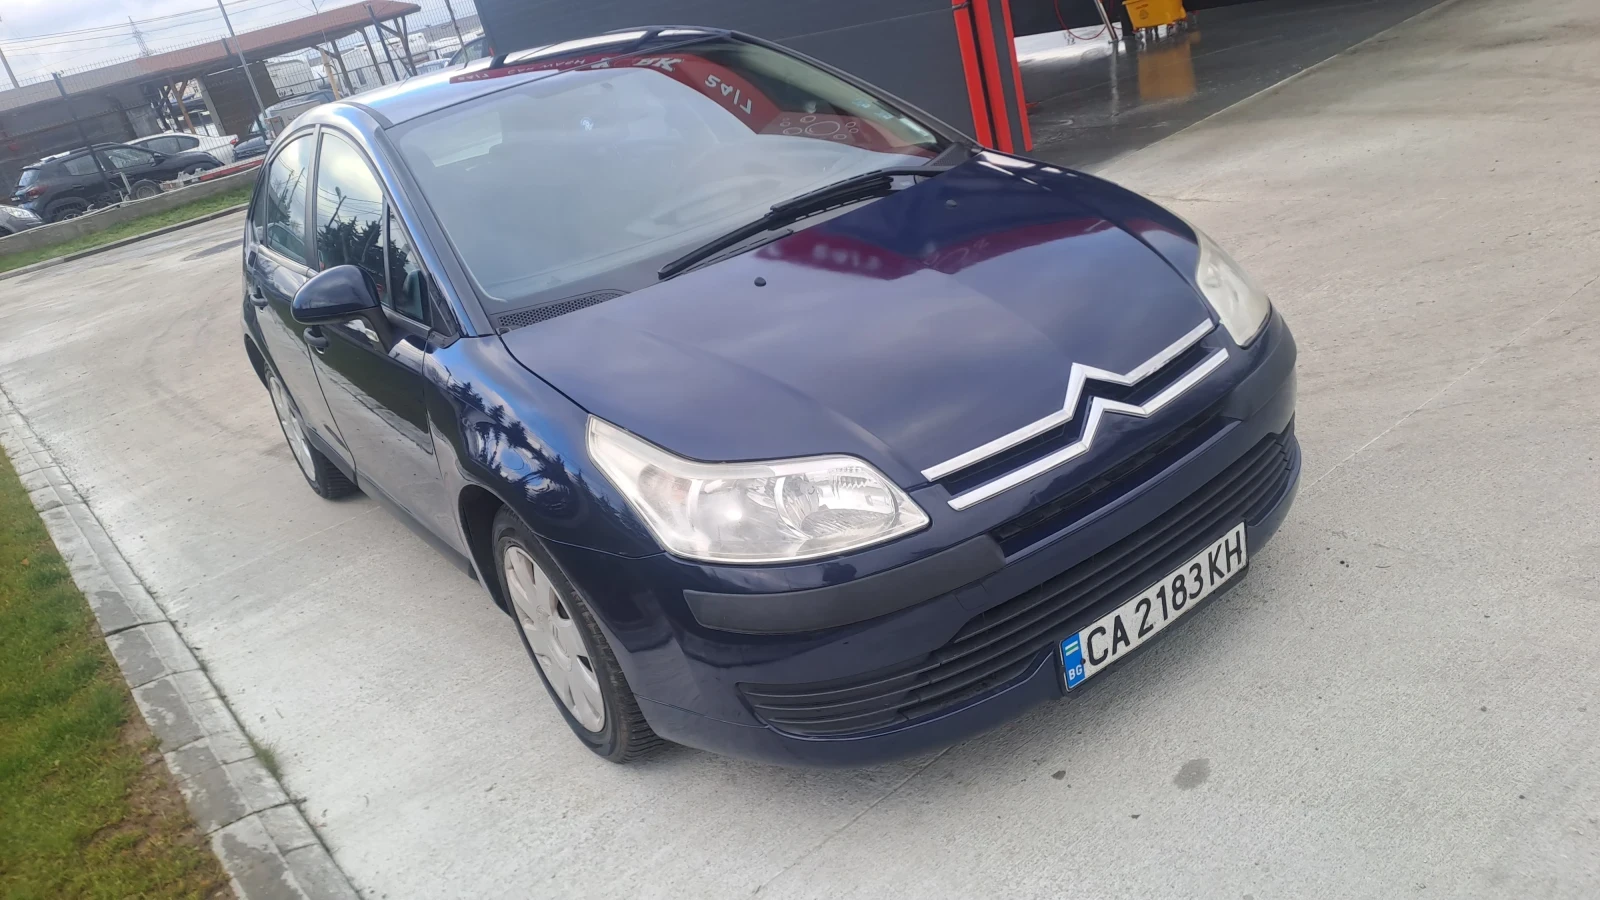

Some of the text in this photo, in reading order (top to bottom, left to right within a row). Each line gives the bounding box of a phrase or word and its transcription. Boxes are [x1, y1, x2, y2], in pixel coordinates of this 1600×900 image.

[1086, 530, 1242, 666] CA 2183 KH
[1068, 664, 1083, 681] BG
